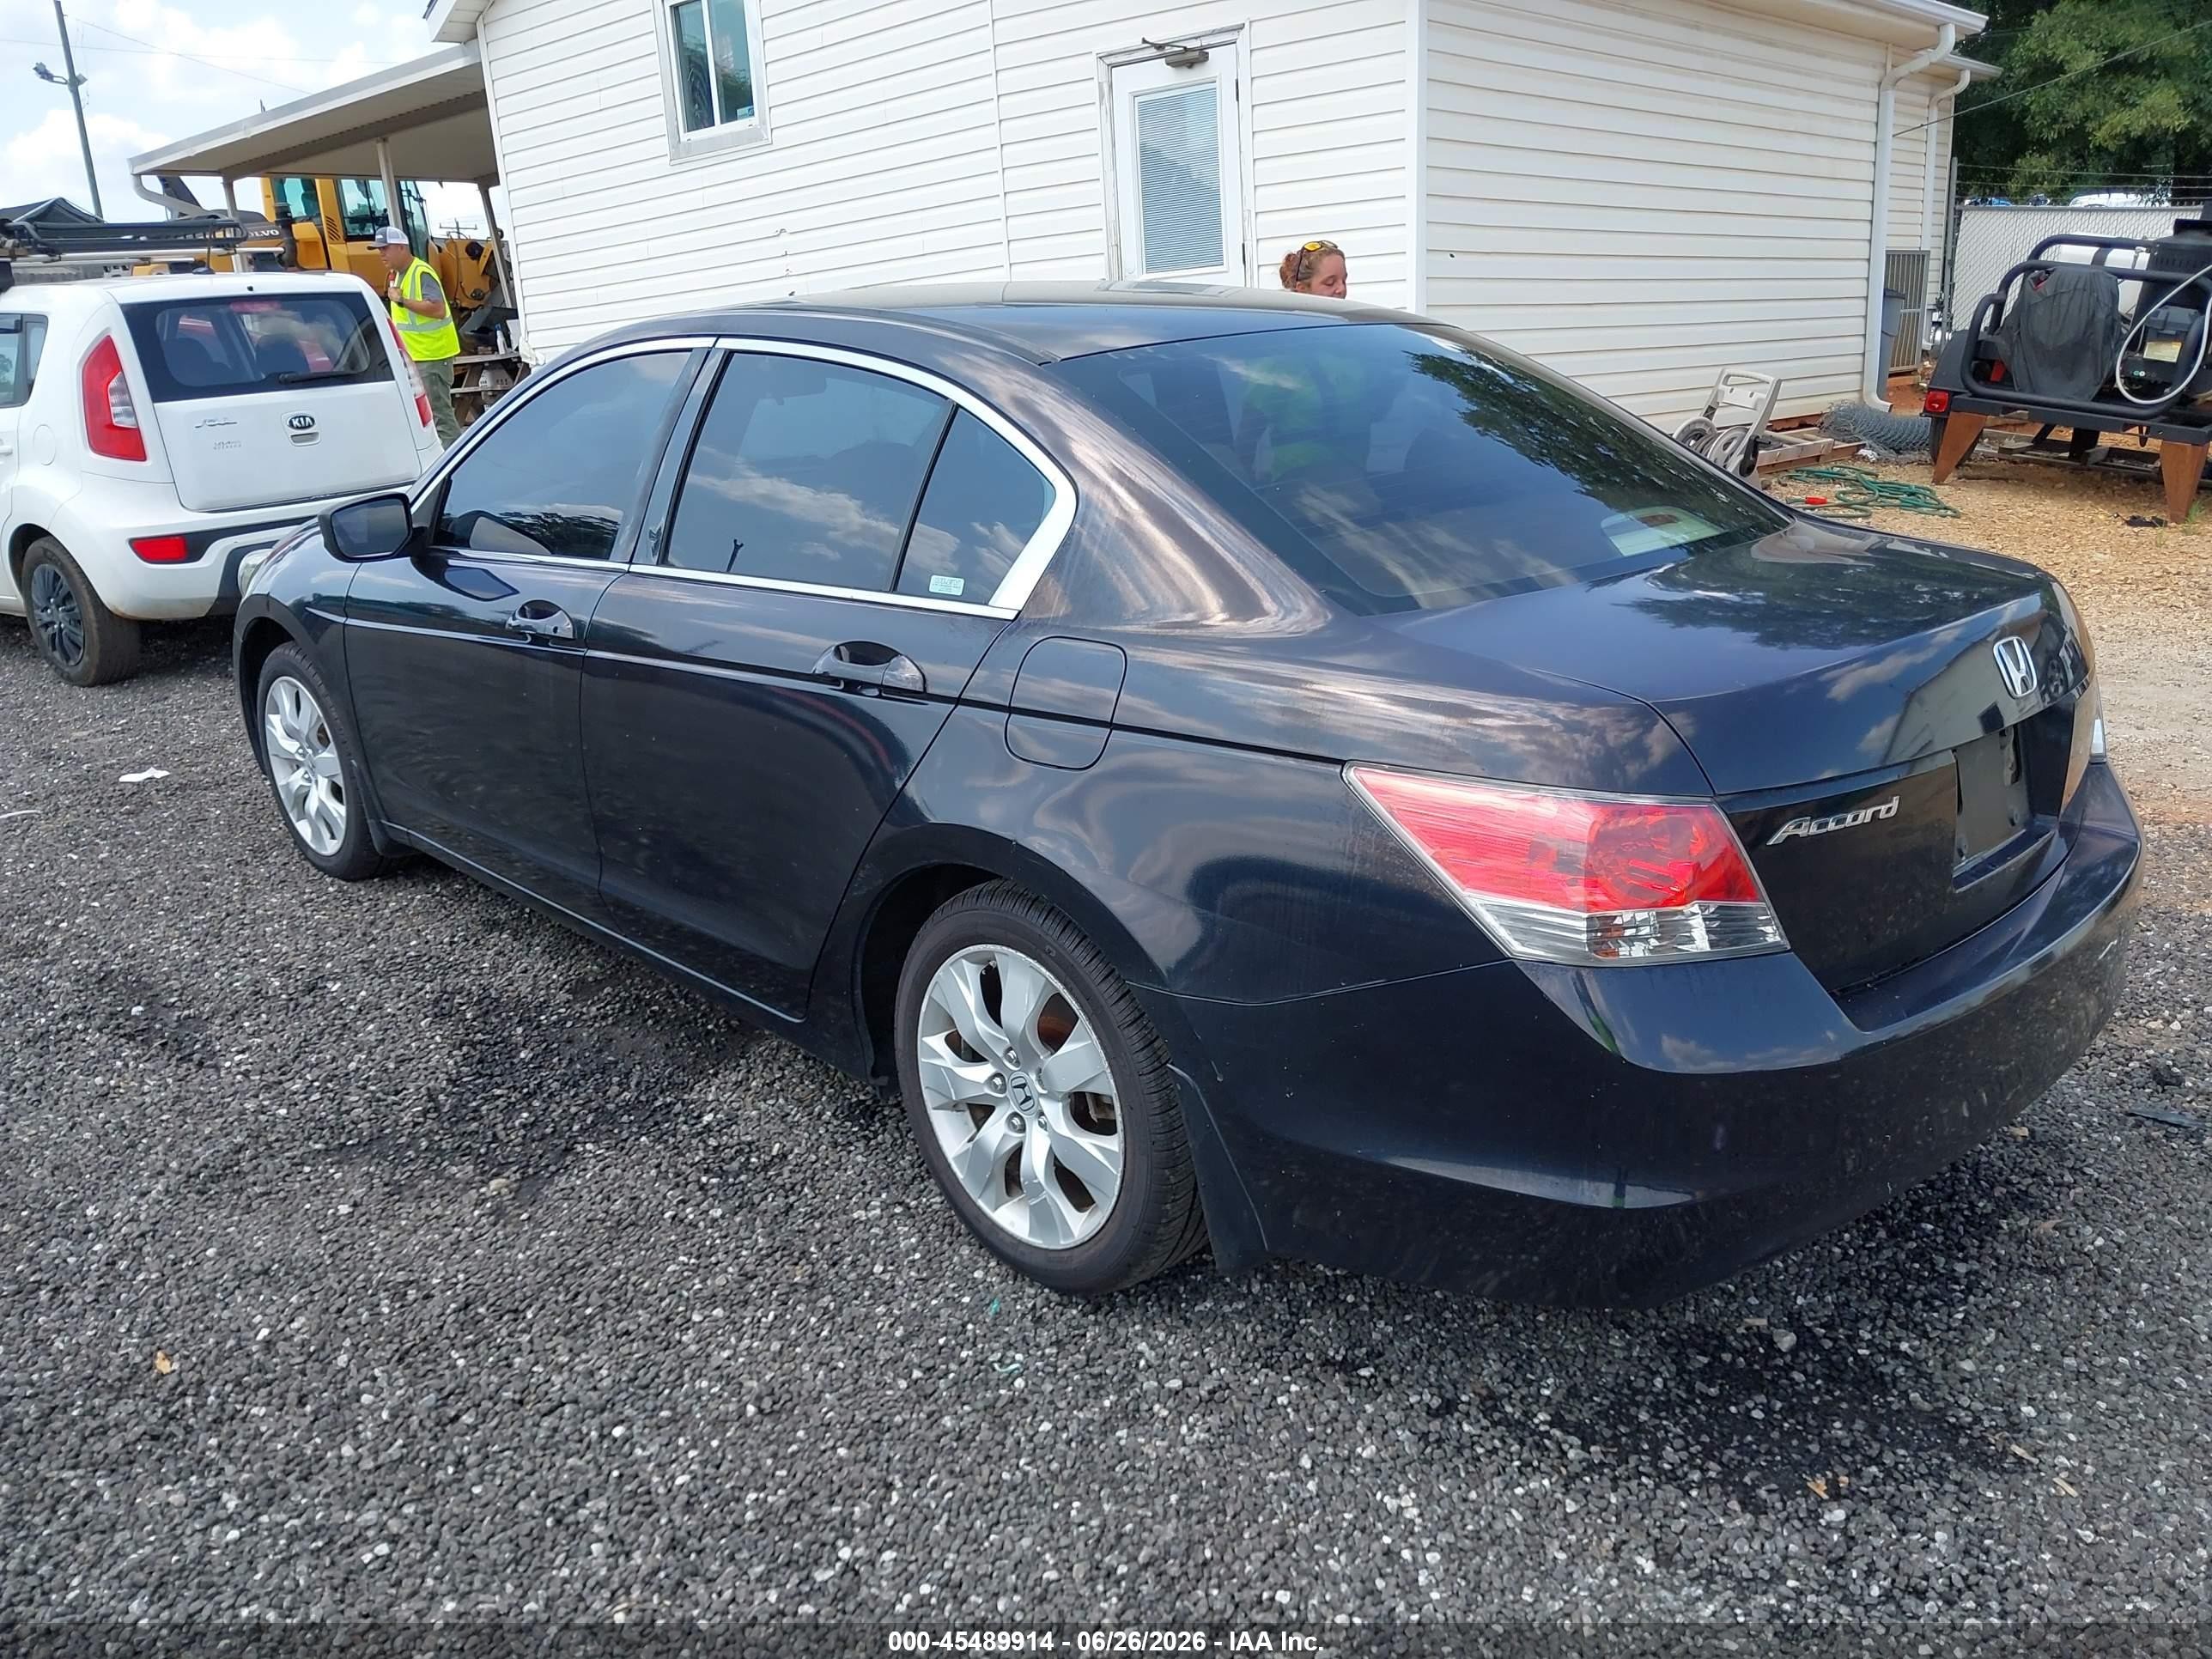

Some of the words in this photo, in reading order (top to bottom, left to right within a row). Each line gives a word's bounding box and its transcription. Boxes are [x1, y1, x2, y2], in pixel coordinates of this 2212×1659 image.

[248, 228, 280, 237] OLVO
[291, 416, 313, 428] KIA
[1765, 795, 1900, 846] Accord
